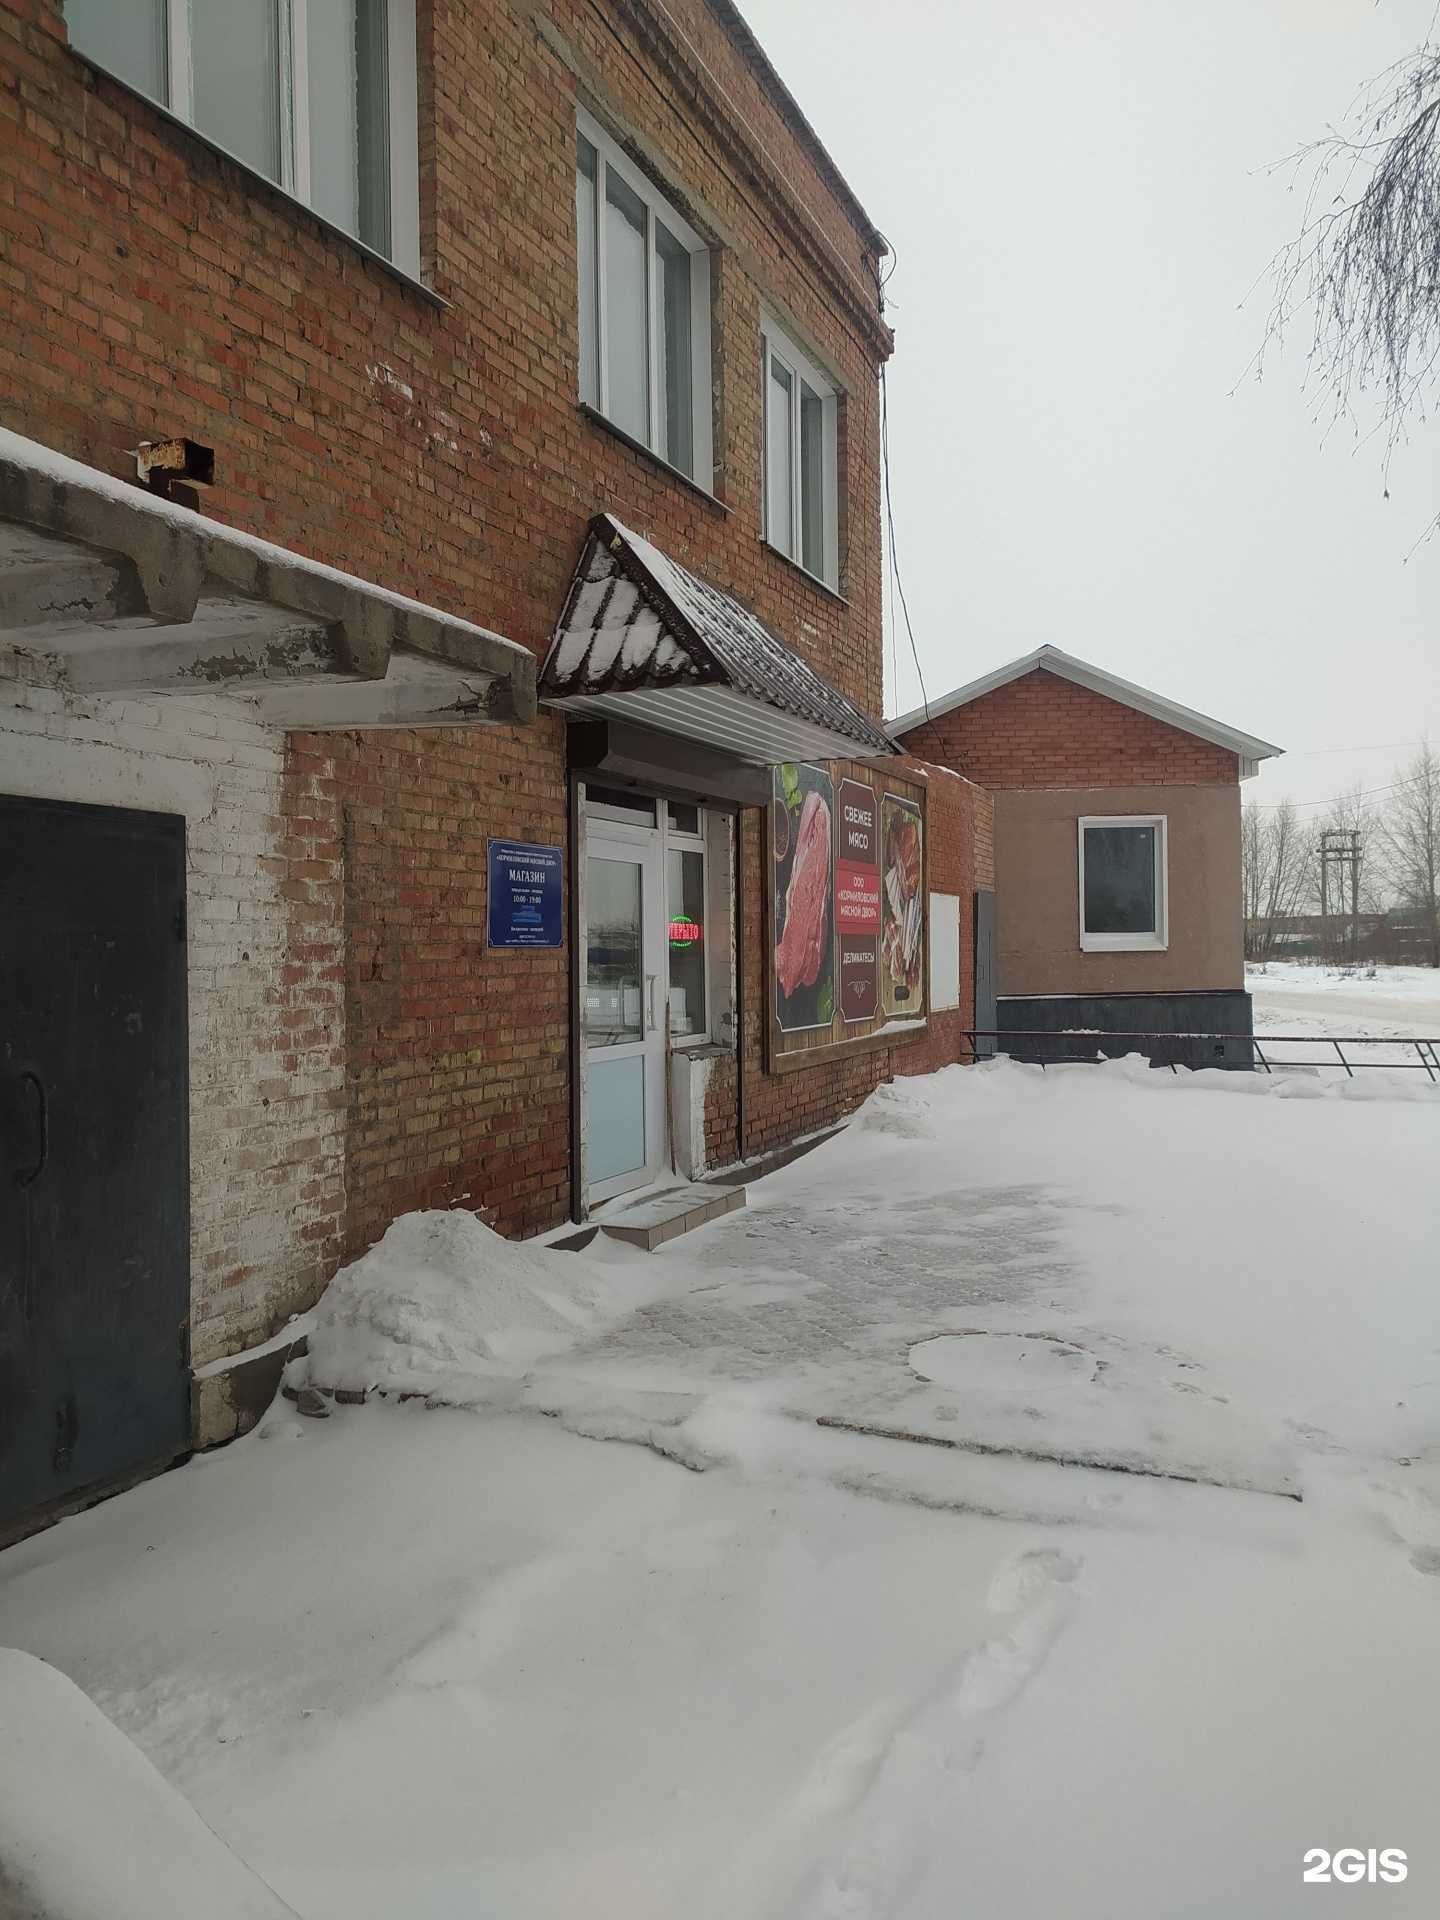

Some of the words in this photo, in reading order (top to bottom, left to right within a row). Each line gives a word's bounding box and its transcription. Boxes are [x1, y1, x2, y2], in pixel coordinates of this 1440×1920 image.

[844, 805, 873, 828] СВЕЖЕЕ
[848, 832, 869, 849] МЯСО
[509, 869, 545, 883] МАГАЗИН
[853, 876, 865, 888] ООО
[842, 951, 875, 965] ДЕЛИКАТЕСЫ
